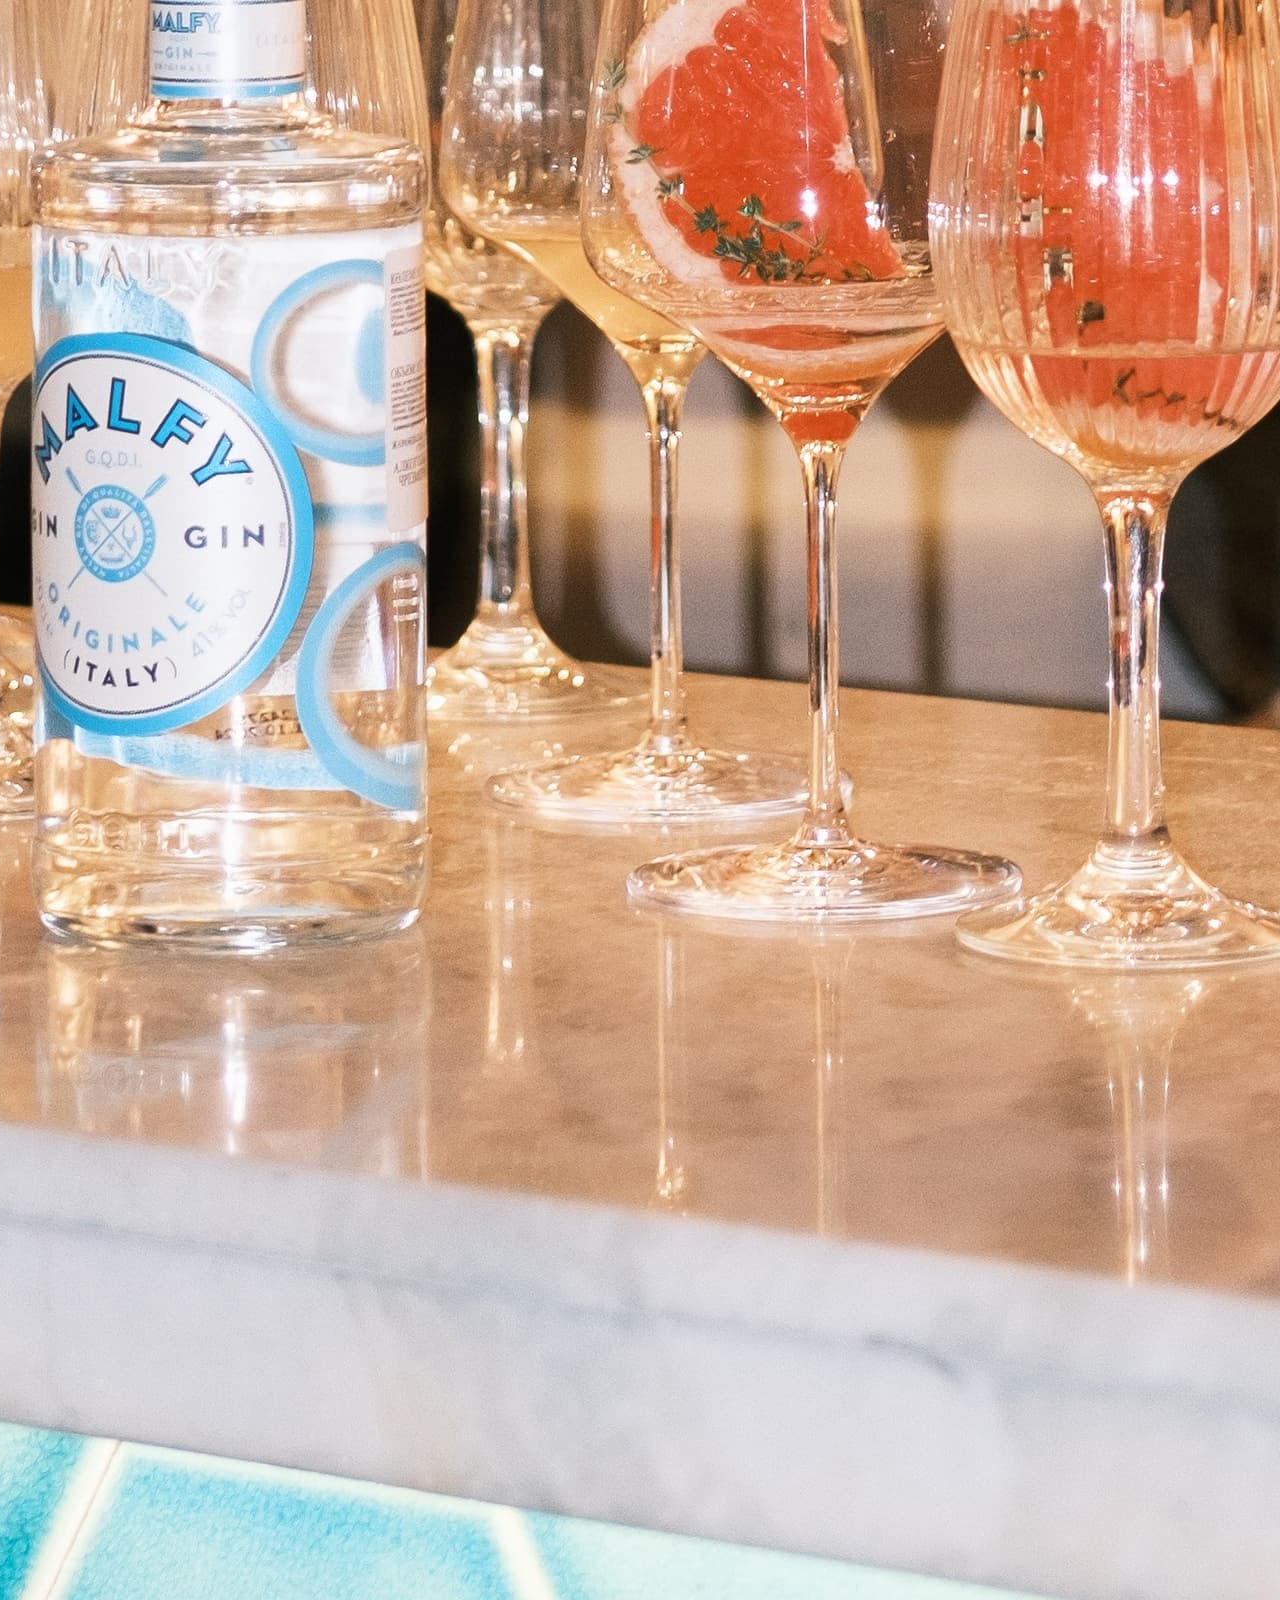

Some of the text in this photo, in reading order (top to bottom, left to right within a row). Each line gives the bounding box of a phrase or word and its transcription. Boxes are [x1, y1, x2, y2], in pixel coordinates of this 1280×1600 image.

[165, 47, 193, 60] GIN
[33, 377, 254, 487] MALFY
[85, 448, 143, 469] G.Q.D.I.
[183, 524, 265, 549] GIN
[48, 582, 207, 654] ORIGINALE
[63, 648, 178, 687] (ITALY)
